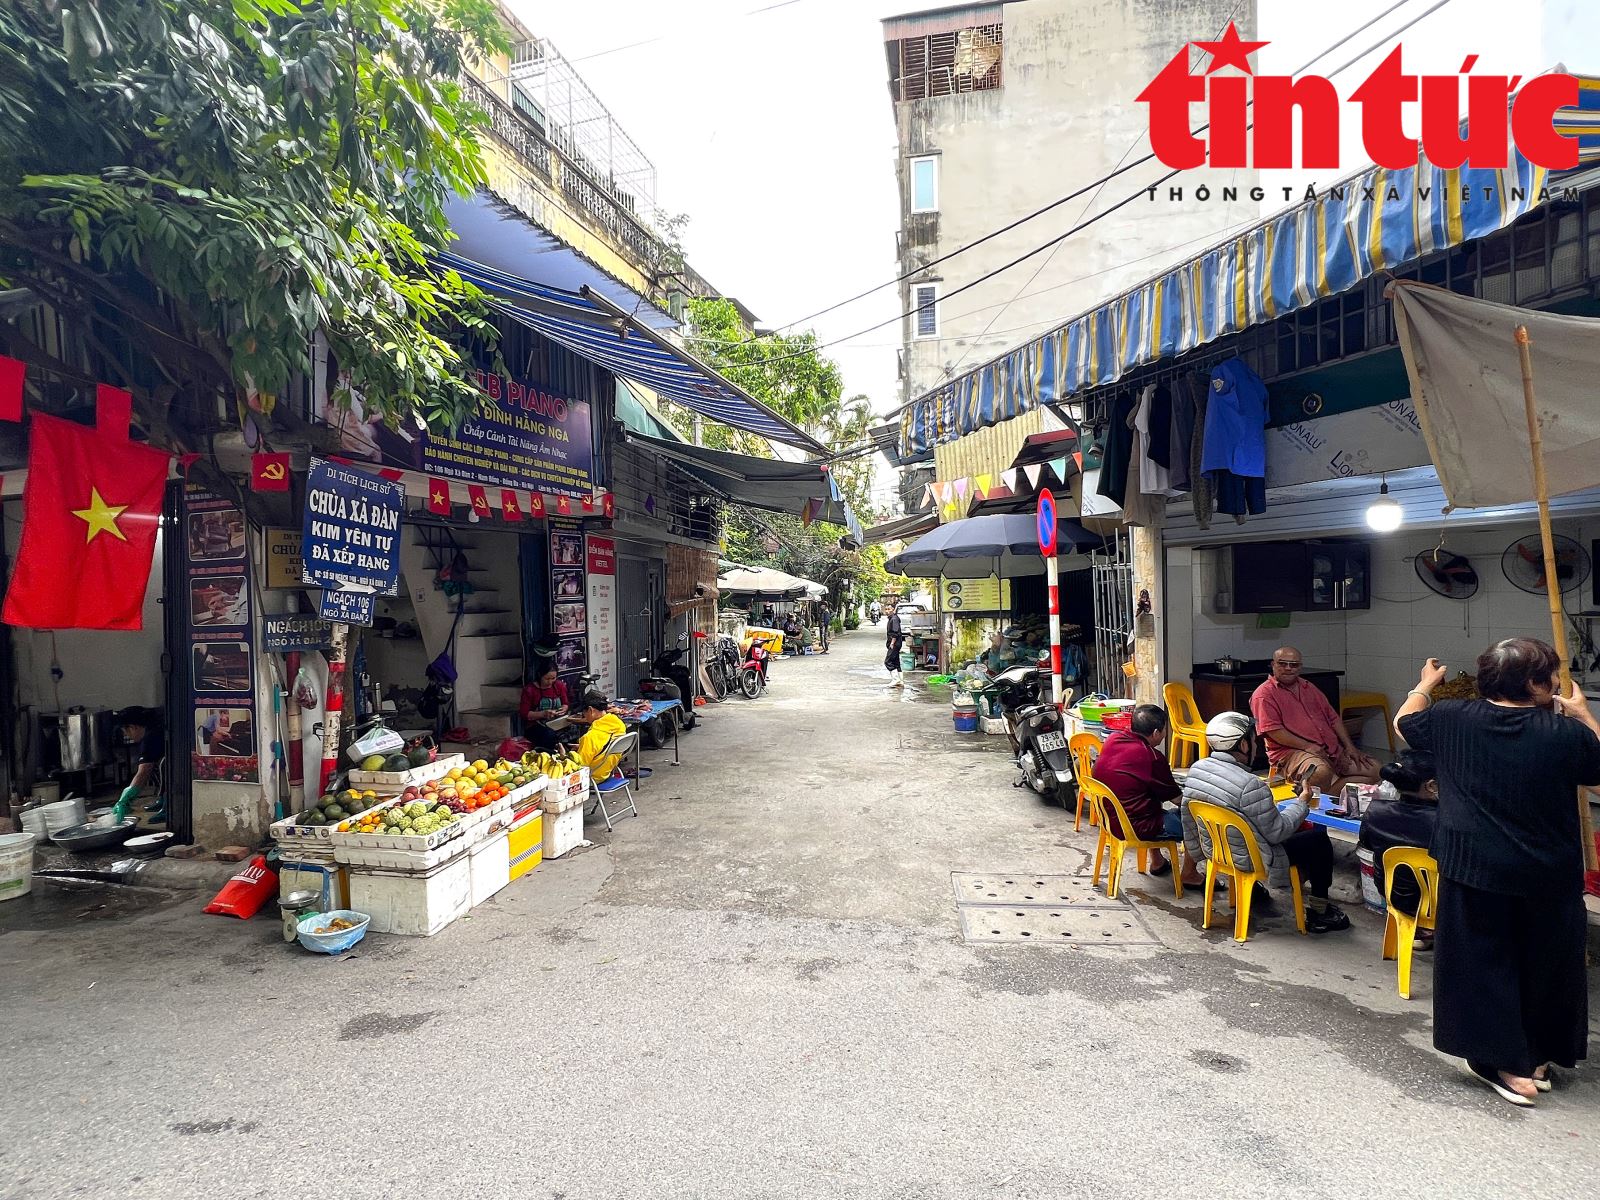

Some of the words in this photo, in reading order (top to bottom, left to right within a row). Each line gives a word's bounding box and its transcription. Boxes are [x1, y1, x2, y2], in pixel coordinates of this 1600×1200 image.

[507, 381, 568, 422] PIANO
[516, 412, 546, 435] HẰNG
[548, 426, 569, 442] NGA
[486, 430, 506, 444] Cánh
[552, 448, 568, 460] Nhạc
[327, 468, 336, 479] DI
[339, 471, 358, 486] TÍCH
[360, 478, 379, 492] LỊCH
[310, 488, 347, 519] CHÙA
[350, 496, 368, 524] XÃ
[371, 503, 398, 531] ĐÀN
[312, 521, 340, 540] KIM
[345, 528, 371, 547] YÊN
[375, 535, 393, 553] TỰ
[312, 543, 330, 561] ĐÃ
[333, 546, 355, 564] XẾP
[358, 554, 389, 570] HẠNG
[326, 591, 356, 606] NGÁCH
[358, 597, 370, 608] 106
[268, 617, 307, 634] NGÁCH
[323, 608, 339, 618] NGÕ
[341, 610, 350, 619] XÃ
[351, 611, 364, 621] ĐÀN
[268, 636, 287, 646] NGÕ
